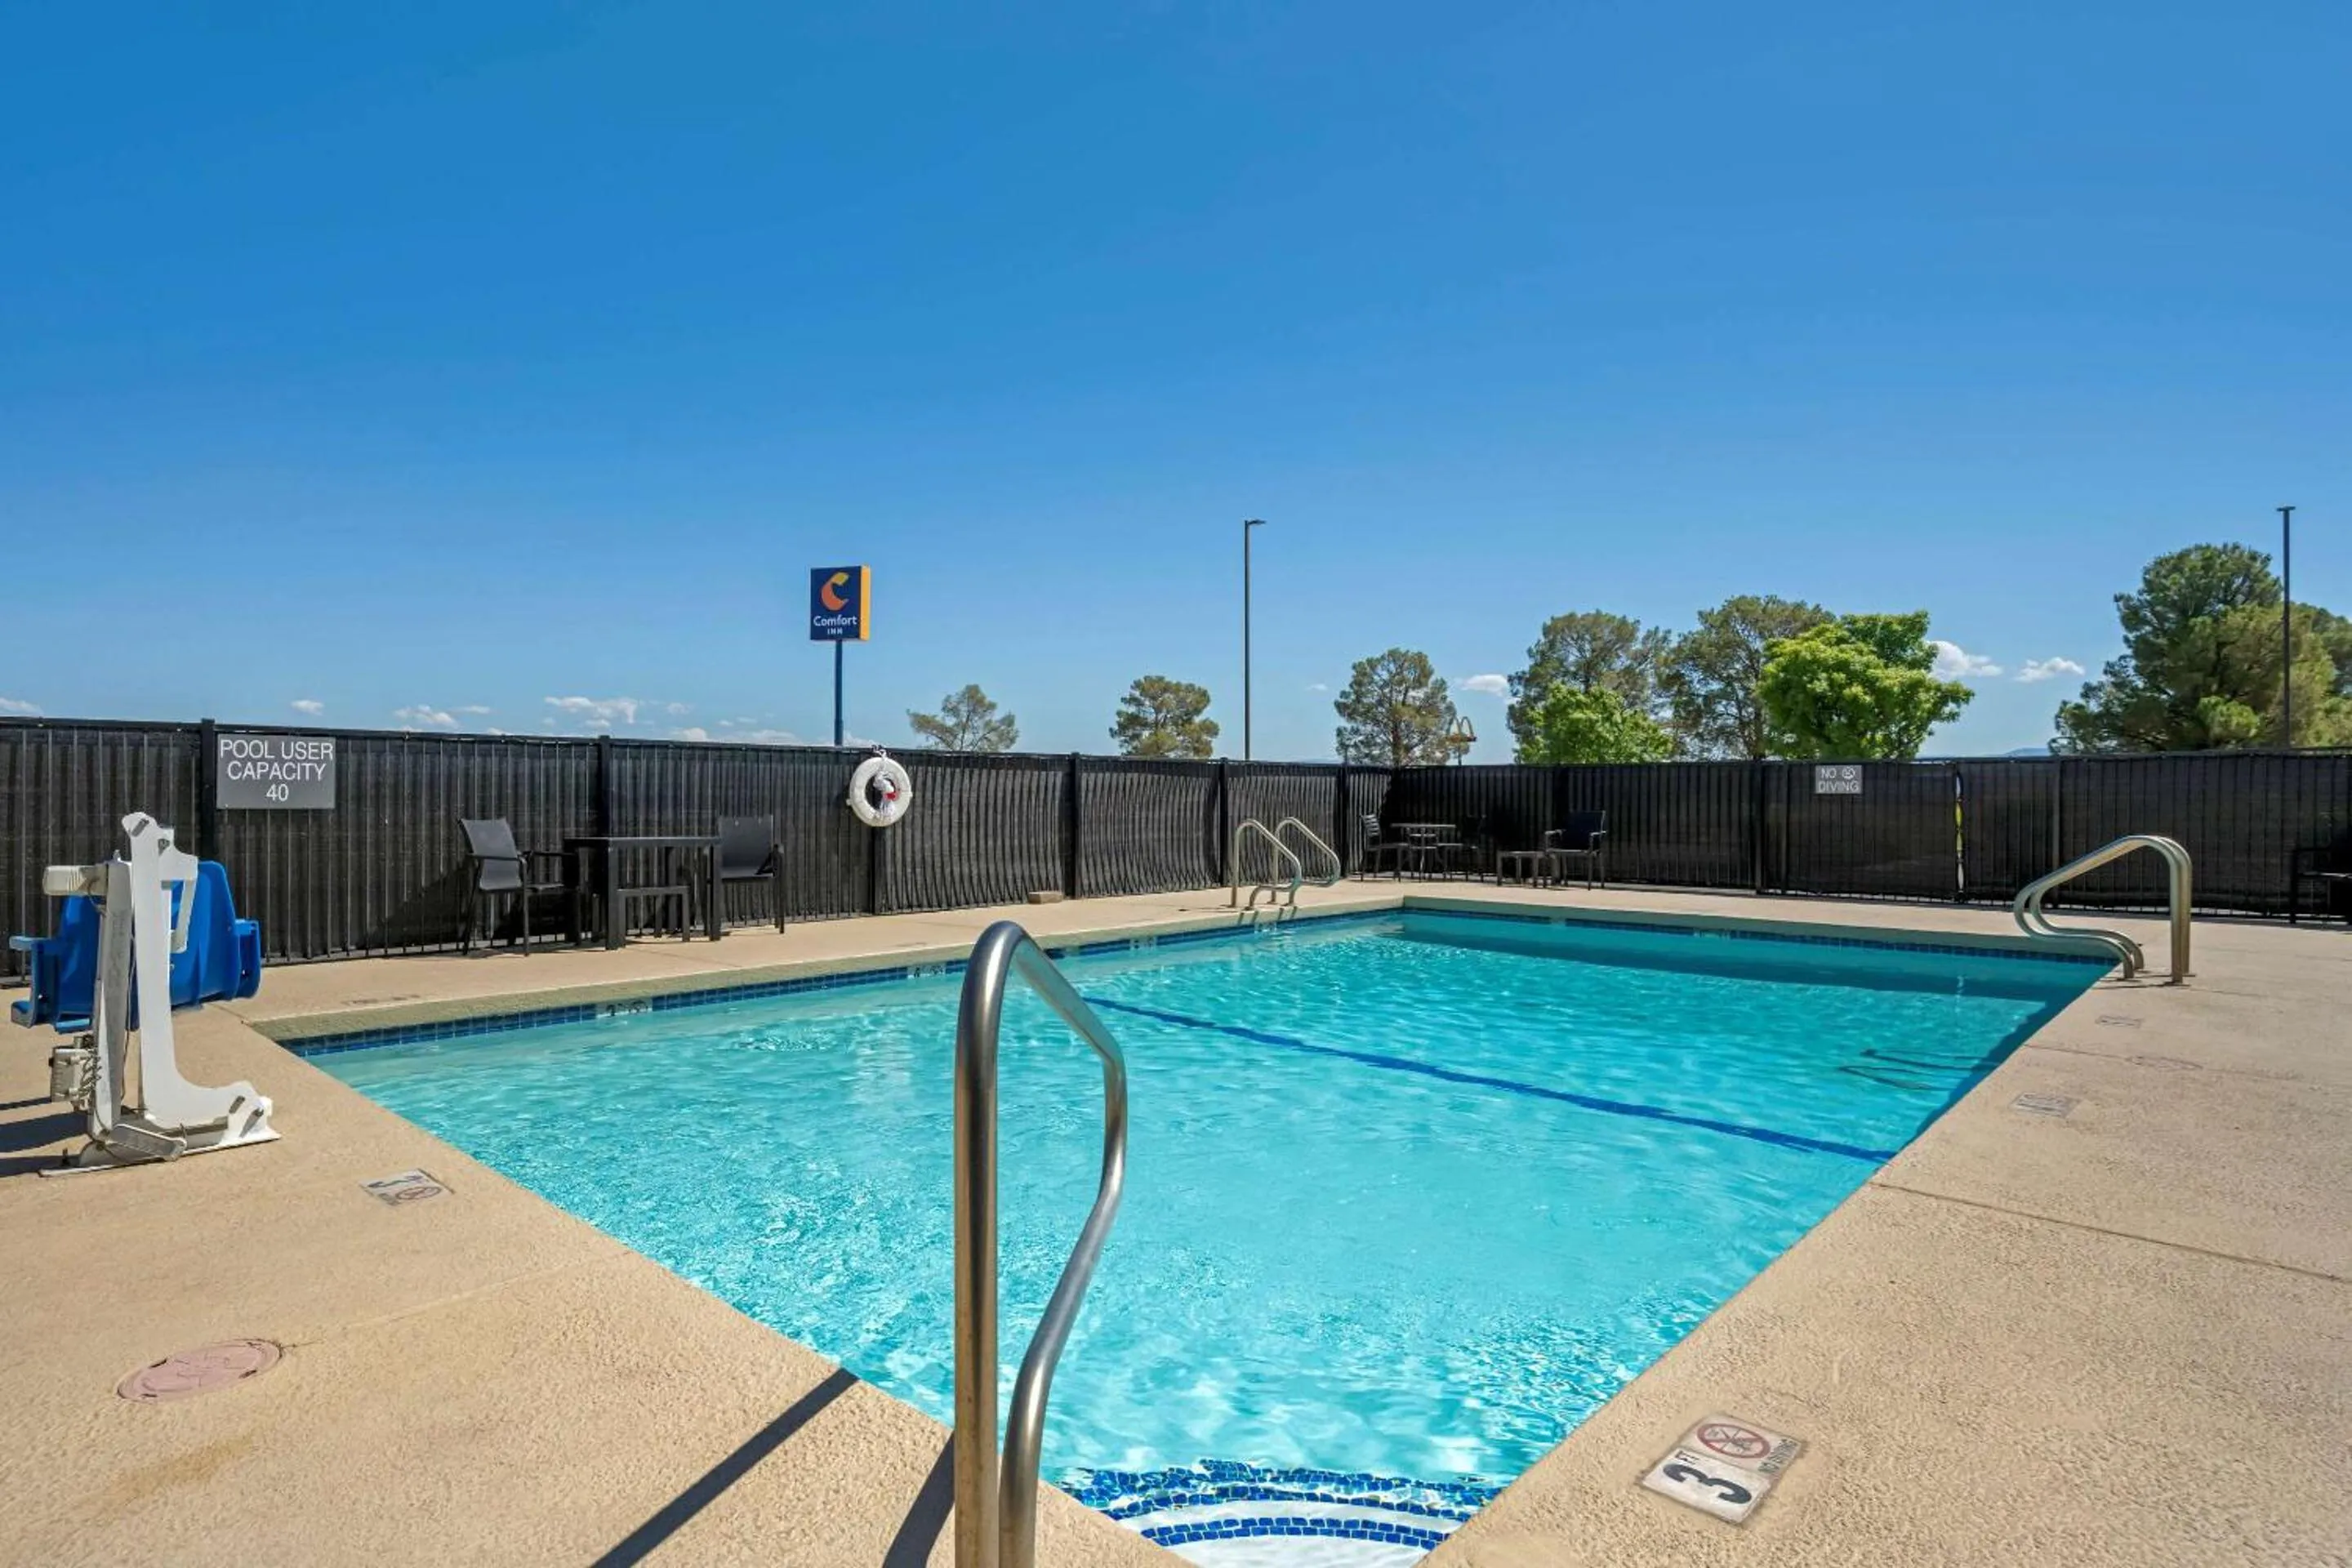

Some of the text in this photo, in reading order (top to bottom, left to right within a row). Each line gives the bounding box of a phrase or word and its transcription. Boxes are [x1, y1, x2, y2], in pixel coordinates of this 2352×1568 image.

[813, 614, 858, 626] Comfort
[220, 739, 334, 760] POOL USER
[227, 760, 327, 781] CAPACITY
[1820, 768, 1837, 778] NO
[266, 783, 289, 802] 40
[1663, 1463, 1753, 1504] 3
